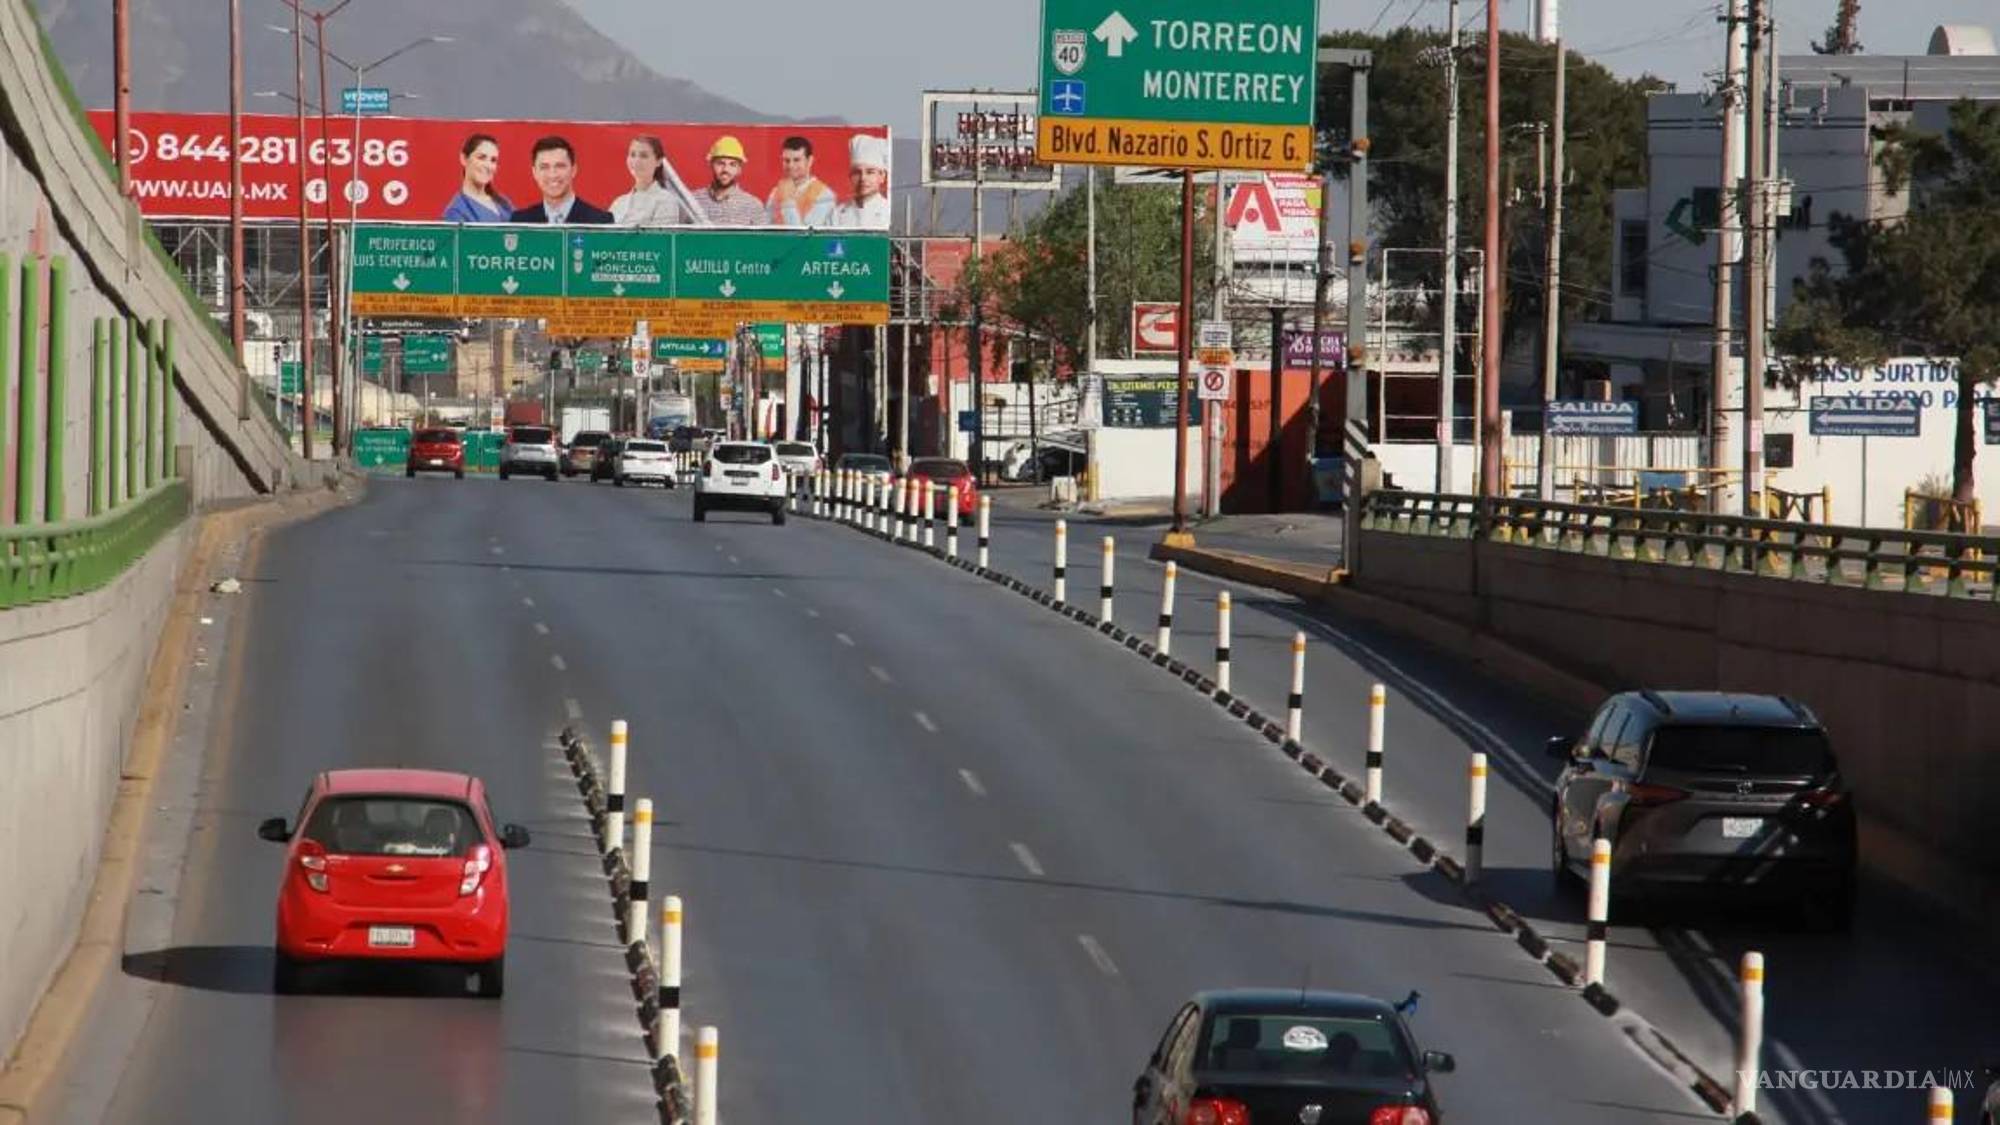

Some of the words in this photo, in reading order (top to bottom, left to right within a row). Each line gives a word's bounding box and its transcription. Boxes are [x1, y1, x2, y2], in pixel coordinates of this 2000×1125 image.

[1150, 19, 1302, 55] TORREON
[1058, 45, 1080, 64] 40
[1142, 69, 1305, 105] MONTERREY
[156, 133, 230, 162] 844
[239, 136, 297, 165] 281
[308, 138, 351, 165] 63
[362, 139, 410, 167] 86
[1052, 125, 1101, 154] Blvd.
[1107, 127, 1189, 157] Nazario
[1196, 128, 1215, 159] S.
[1220, 129, 1273, 160] Ortiz
[1282, 132, 1301, 162] G.
[368, 237, 436, 252] PERIFERICO
[353, 254, 375, 268] LUIS
[440, 256, 448, 269] A
[466, 254, 556, 271] TORREON
[591, 250, 661, 262] MONTERREY
[685, 259, 730, 275] SALTILLO
[735, 260, 771, 276] Centro
[800, 260, 873, 276] ARTEAGA
[1548, 401, 1635, 413] SALIDA
[1813, 397, 1916, 412] SALIDA
